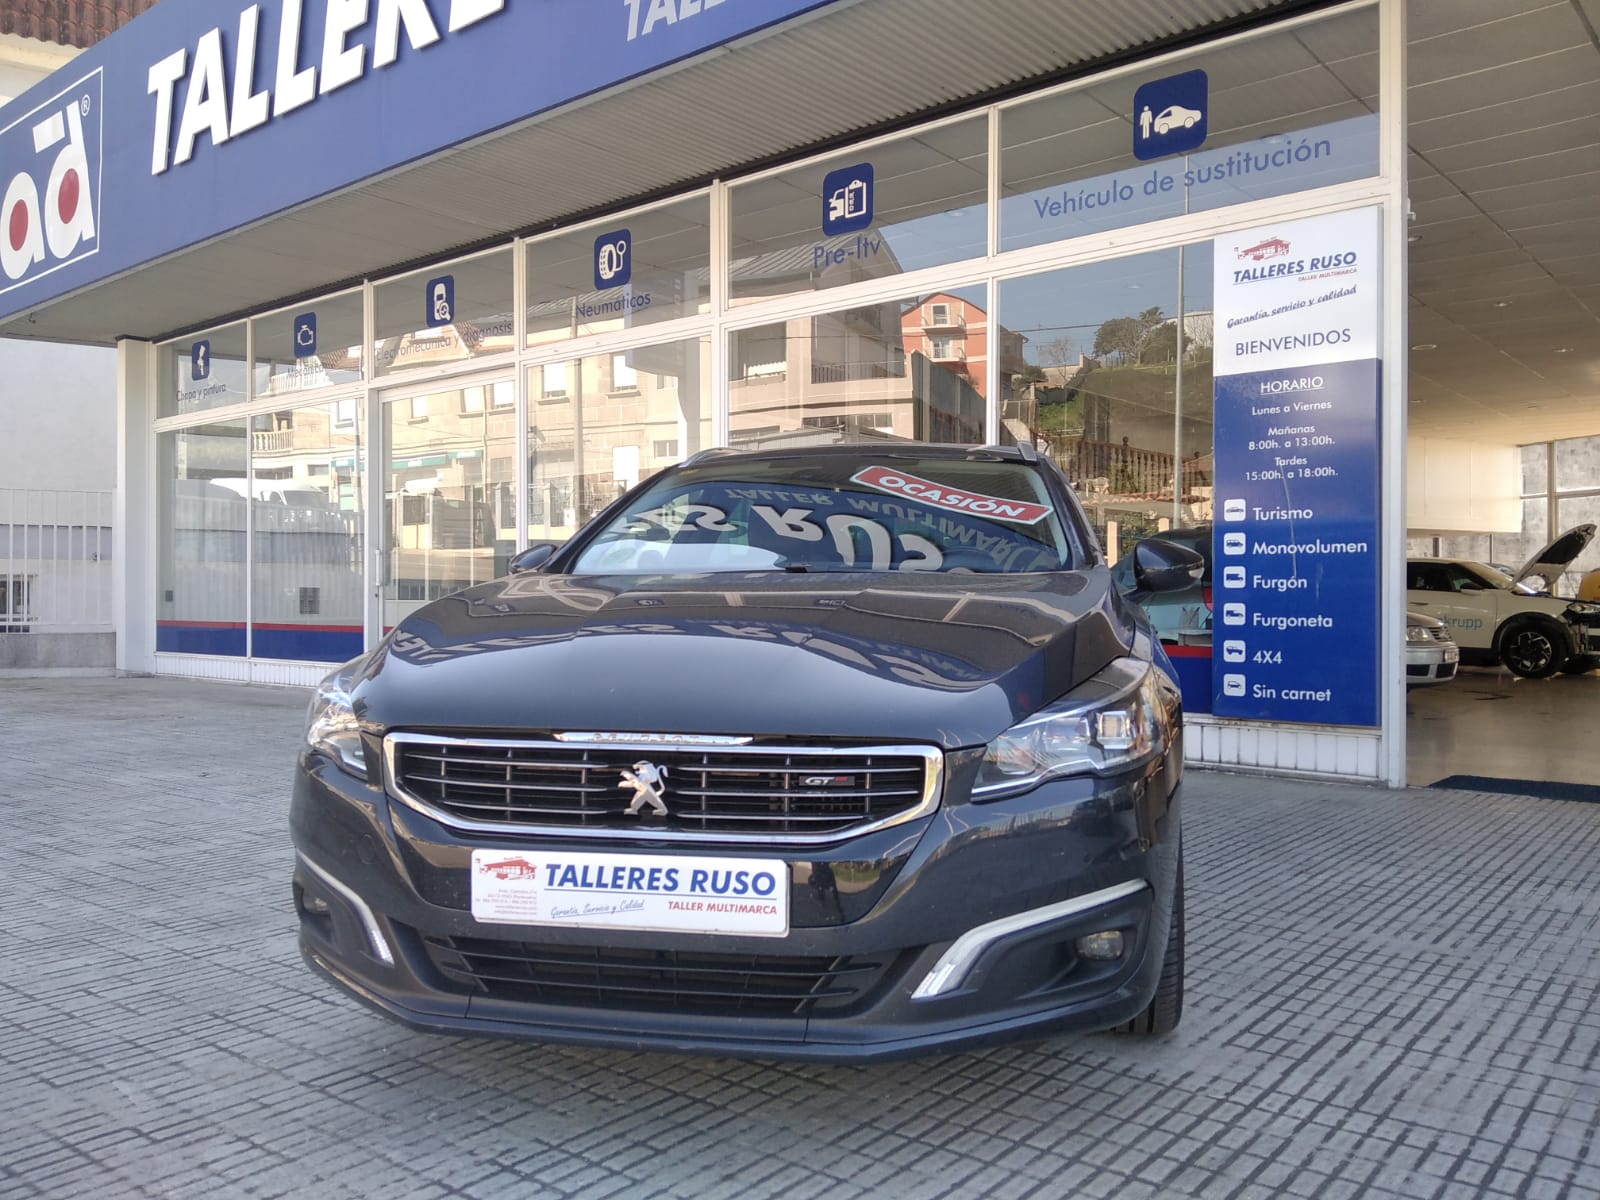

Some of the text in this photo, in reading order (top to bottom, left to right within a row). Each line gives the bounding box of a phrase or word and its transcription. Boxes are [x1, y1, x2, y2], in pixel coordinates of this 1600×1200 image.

[1034, 137, 1332, 219] Vehículo de sustitución
[1234, 251, 1357, 283] TALLERES RUSO
[1317, 284, 1357, 304] calidad
[1235, 329, 1351, 357] BIENVENIDOS
[1260, 376, 1324, 394] HORARIO
[1252, 400, 1332, 417] Lunes a Viernes
[1268, 423, 1315, 436] Mañanas
[1249, 435, 1335, 451] 8:00h. a 13:00h.
[1274, 456, 1307, 467] Tardes
[1246, 467, 1338, 482] 15:00h. a 18:00h.
[879, 475, 1025, 518] OCASIÓN
[1253, 507, 1313, 520] Turismo
[1252, 539, 1368, 555] Monovolumen
[1253, 574, 1308, 592] Furgón
[1253, 613, 1333, 630] Furgoneta
[1253, 651, 1282, 664] 4X4
[1252, 684, 1332, 701] Sin carnet
[545, 864, 776, 896] TALLERES RUSO
[668, 900, 778, 914] TALLER MULTIMARCA
